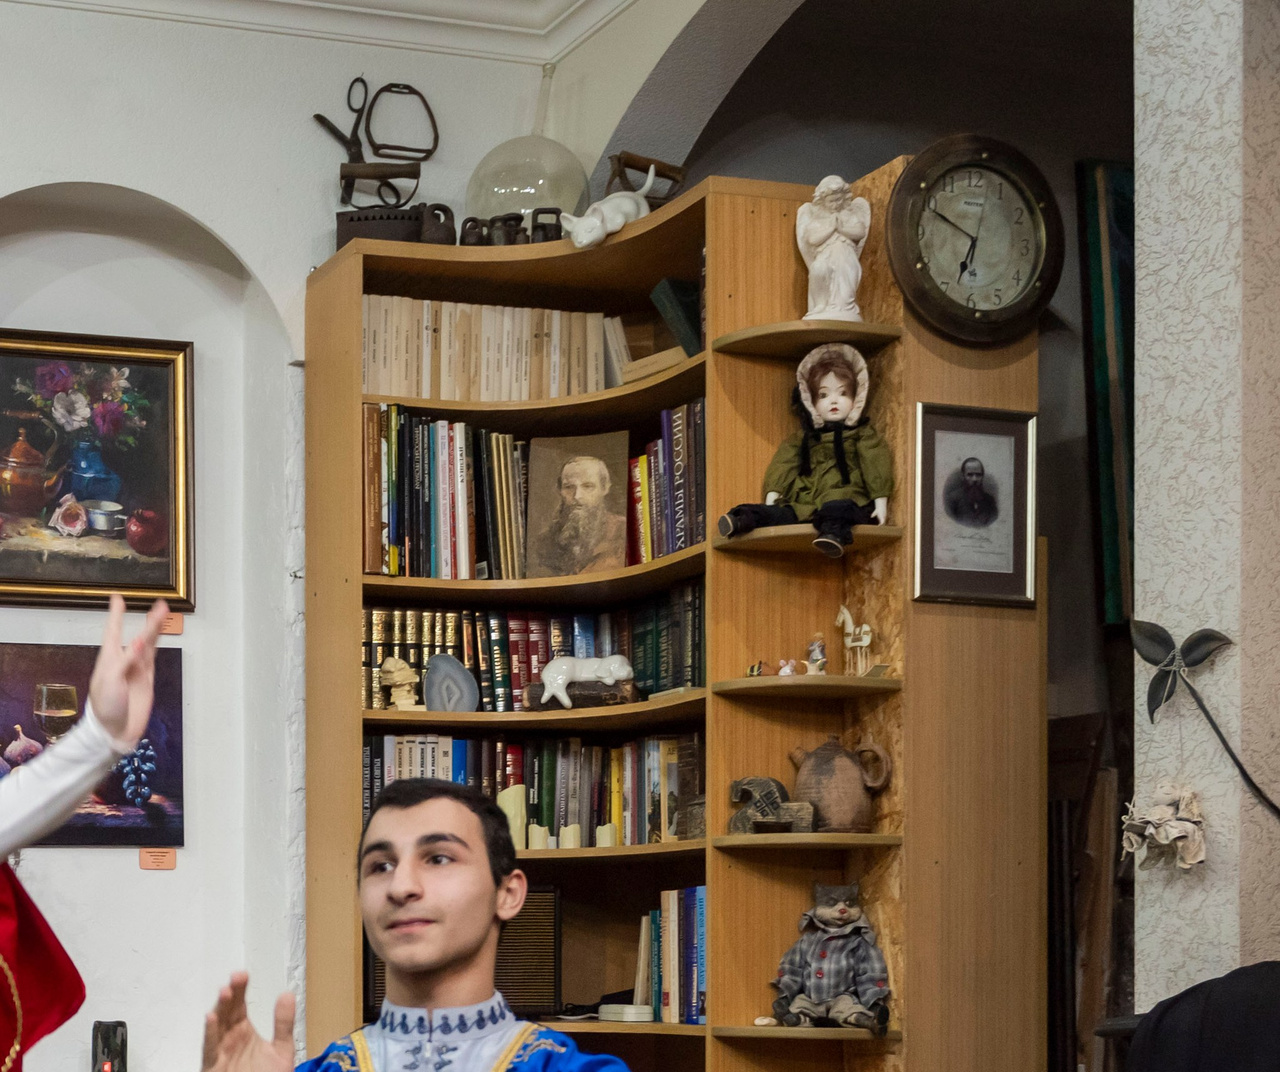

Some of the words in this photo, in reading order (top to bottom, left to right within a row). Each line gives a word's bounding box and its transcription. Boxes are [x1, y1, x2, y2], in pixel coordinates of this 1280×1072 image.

[942, 176, 955, 193] 11
[966, 171, 983, 188] 12
[996, 182, 1003, 200] 1
[1014, 207, 1024, 225] 2
[1021, 239, 1030, 256] 3
[1012, 269, 1023, 286] 4
[967, 293, 976, 309] 6
[993, 289, 1002, 306] 5
[672, 412, 684, 485] РОССИИ
[674, 490, 685, 548] ХРАМЫ
